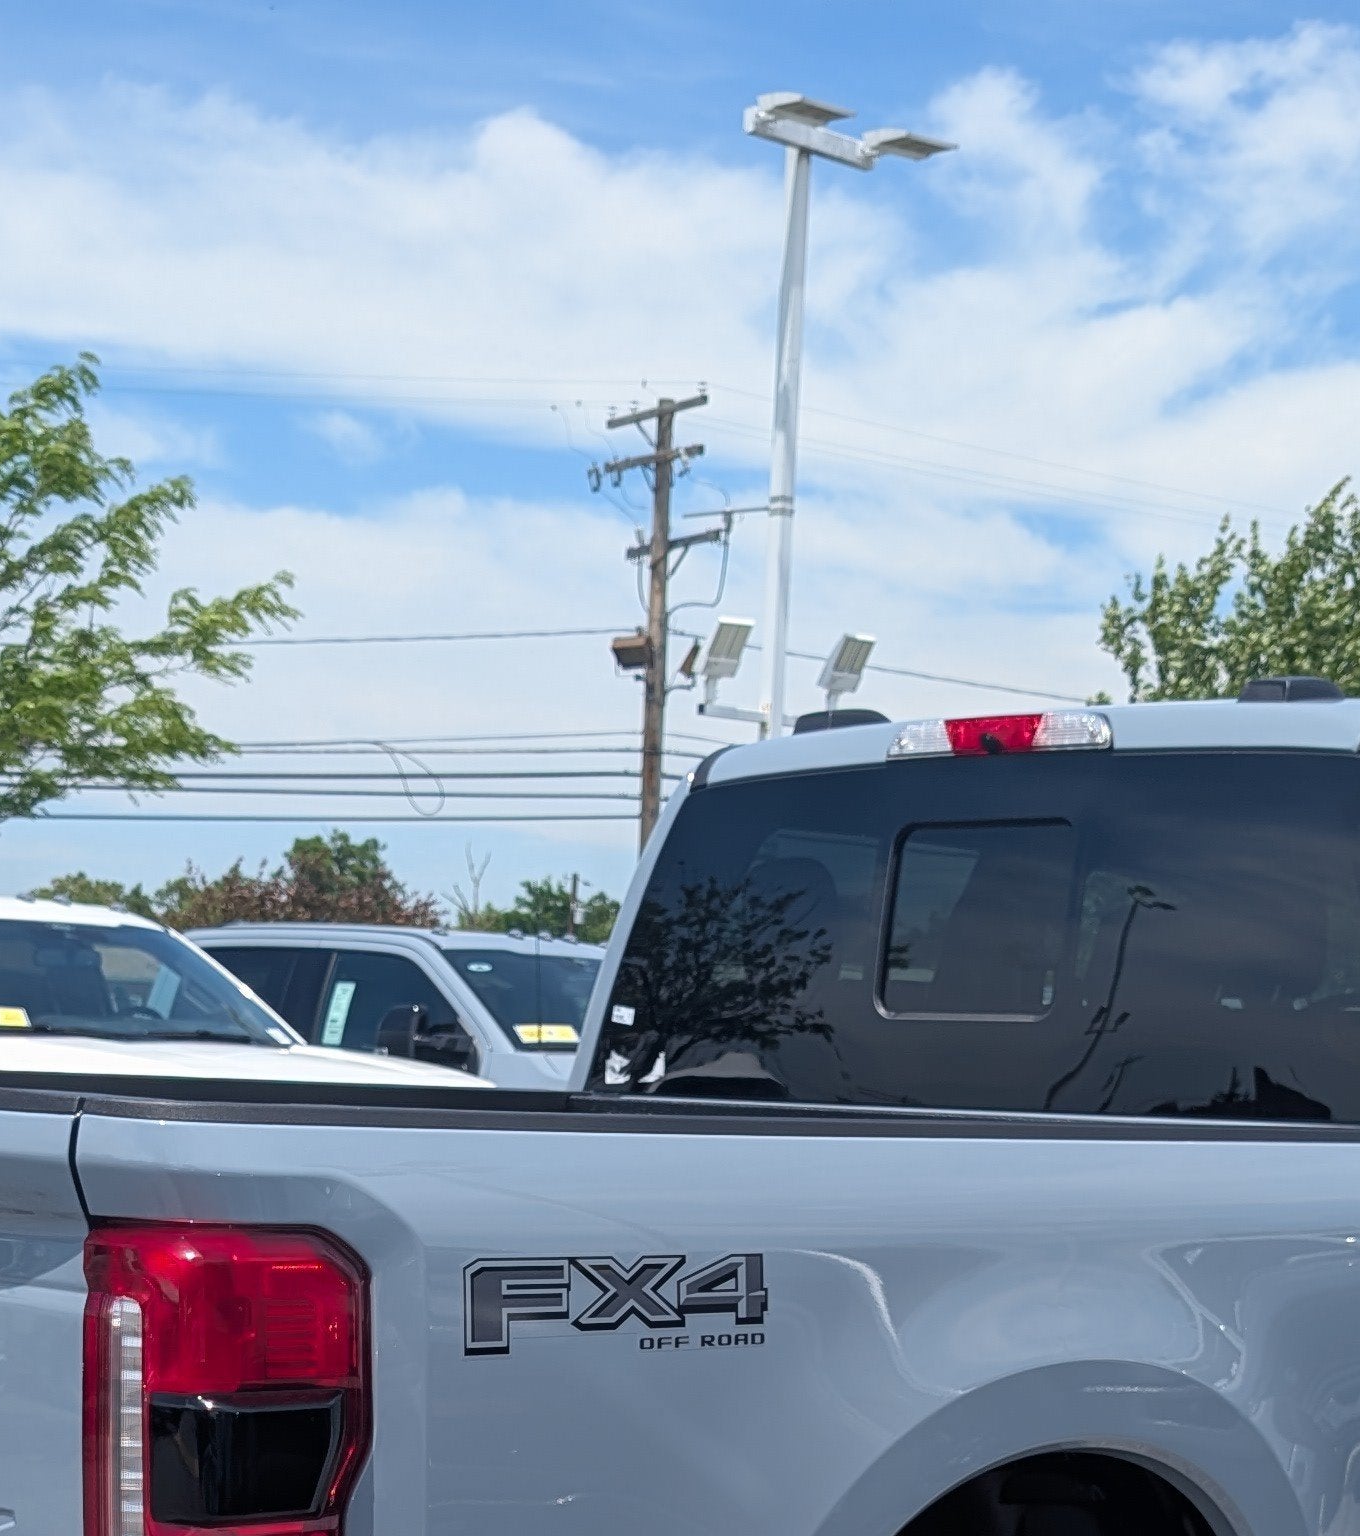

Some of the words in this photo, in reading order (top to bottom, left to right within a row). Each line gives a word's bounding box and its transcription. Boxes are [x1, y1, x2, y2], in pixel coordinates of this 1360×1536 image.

[463, 1253, 768, 1356] FX4
[640, 1336, 689, 1350] OFF
[700, 1332, 765, 1347] ROAD
